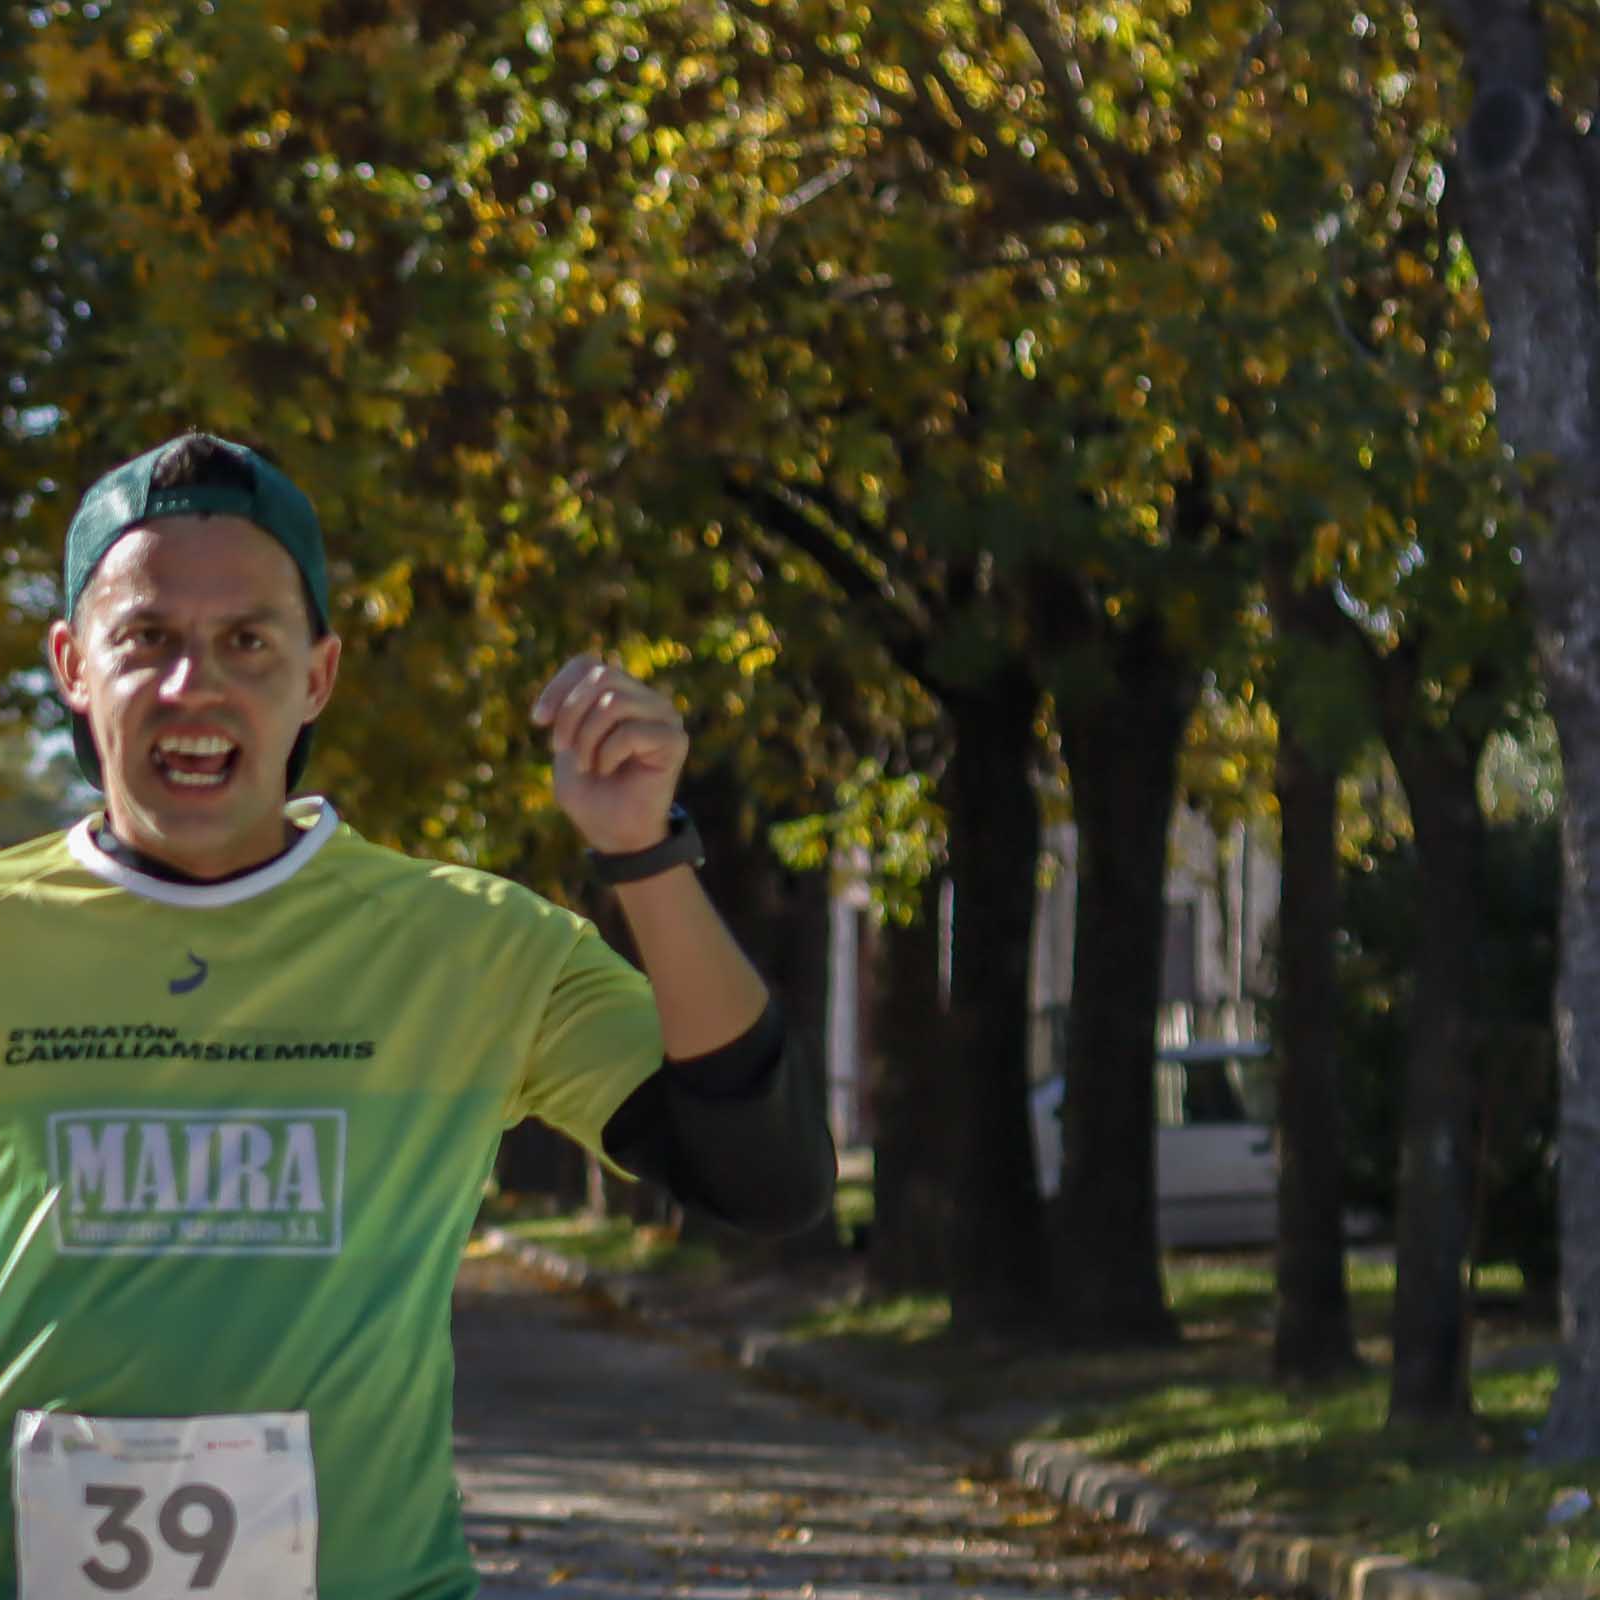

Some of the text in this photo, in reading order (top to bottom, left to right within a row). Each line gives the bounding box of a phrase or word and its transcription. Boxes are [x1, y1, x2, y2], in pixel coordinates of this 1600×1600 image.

[5, 1039, 377, 1066] CAWILLIAMSKEMMIS
[67, 1121, 325, 1213] MAIRA
[81, 1482, 238, 1591] 39
